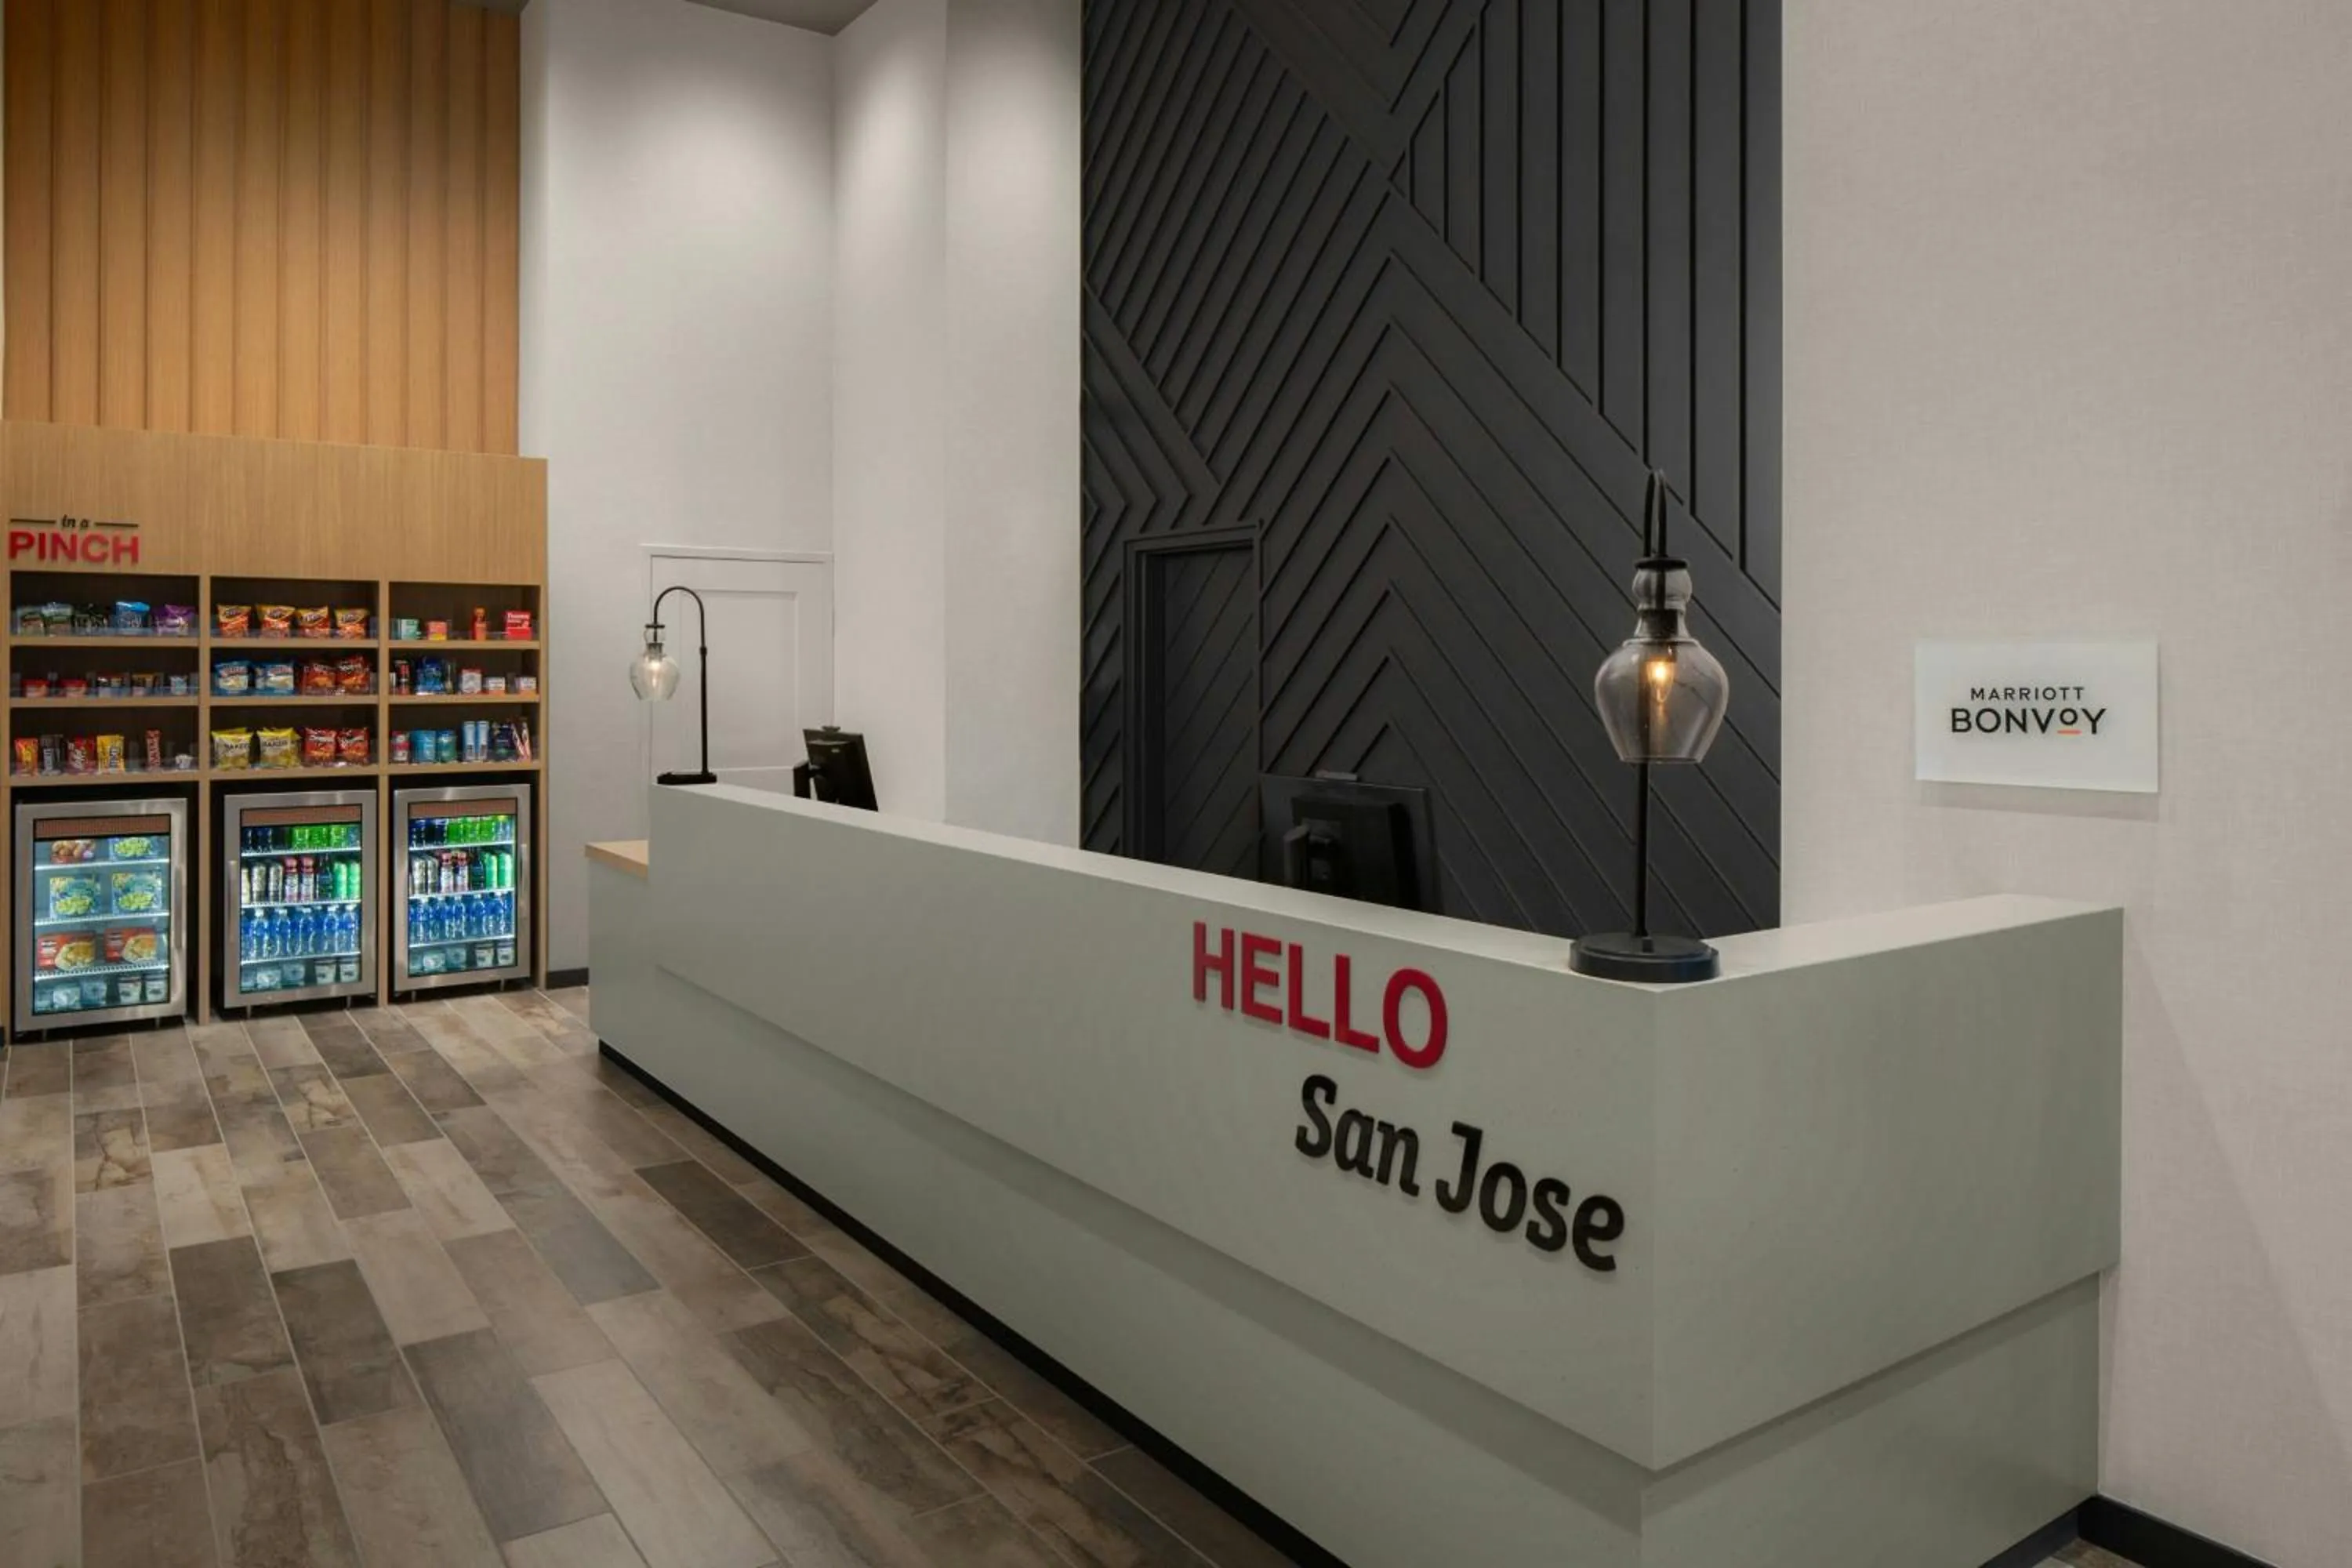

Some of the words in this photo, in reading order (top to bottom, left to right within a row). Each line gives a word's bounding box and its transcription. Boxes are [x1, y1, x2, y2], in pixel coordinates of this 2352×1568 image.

[61, 514, 77, 528] in
[80, 518, 90, 529] a
[9, 531, 139, 565] PINCH
[1970, 686, 2085, 701] MARRIOTT
[1951, 707, 2107, 735] BONVOY
[1192, 921, 1448, 1069] HELLO
[1295, 1074, 1420, 1197] San
[1436, 1120, 1625, 1272] Jose
